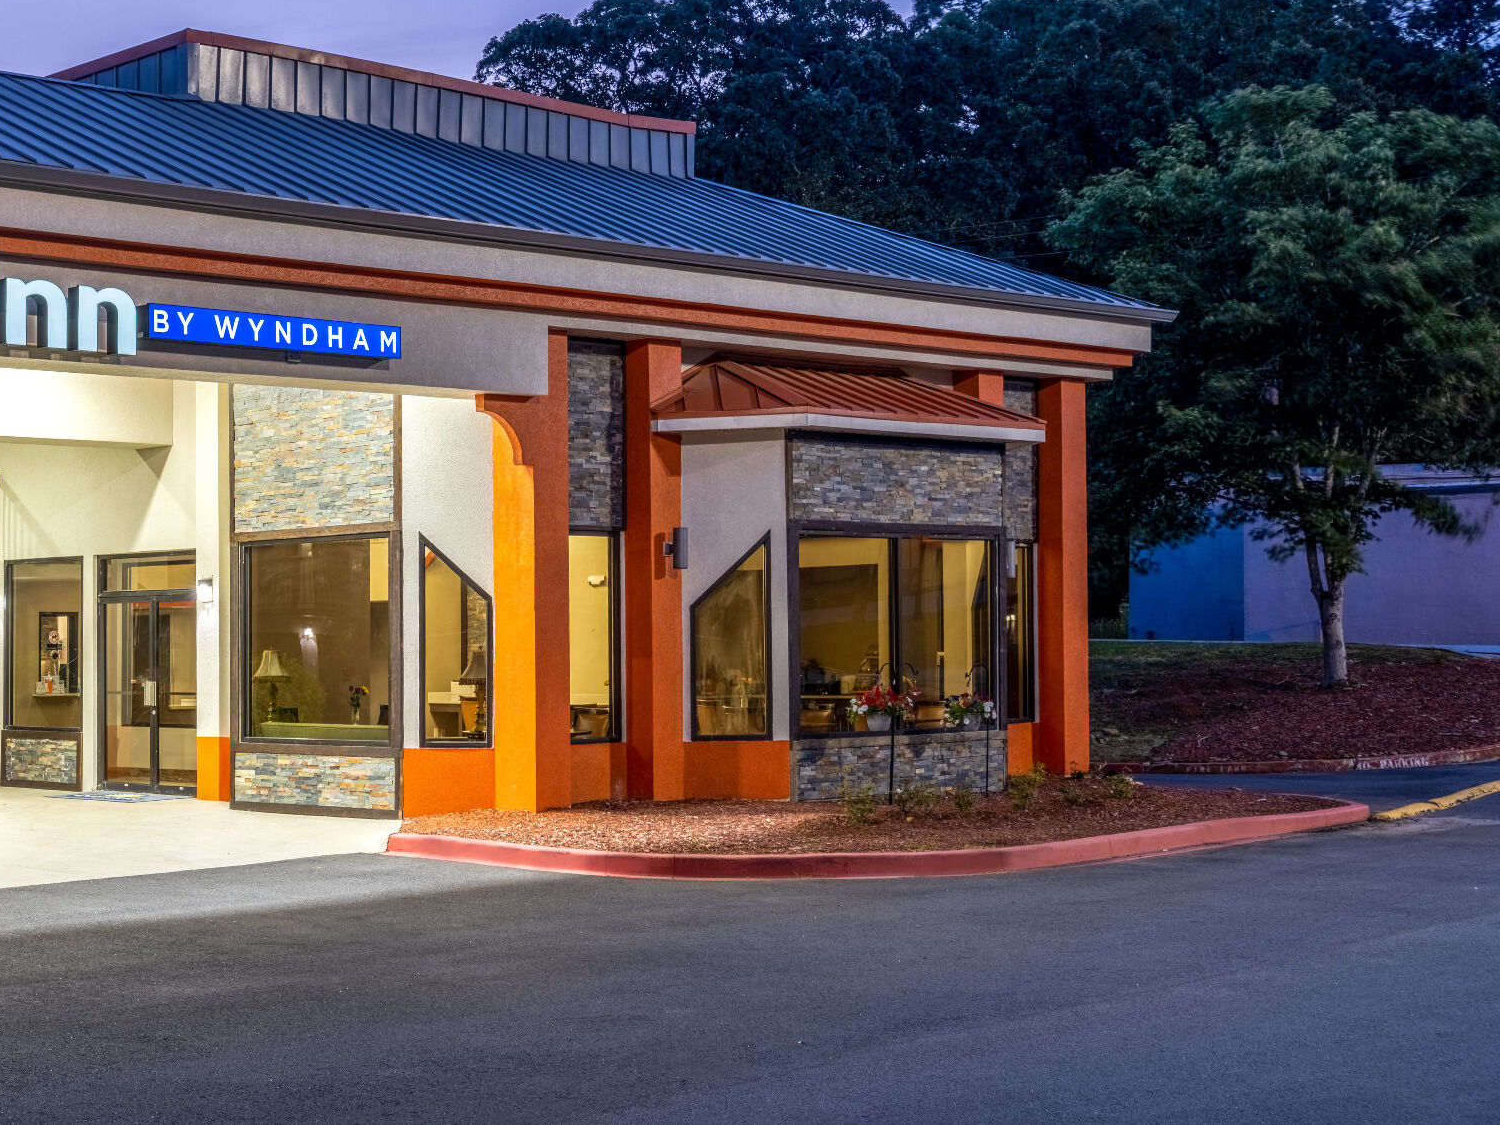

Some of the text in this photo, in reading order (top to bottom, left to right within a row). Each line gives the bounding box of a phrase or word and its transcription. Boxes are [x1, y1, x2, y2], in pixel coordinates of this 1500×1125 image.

[153, 309, 397, 353] BY WYNDHAM
[1380, 757, 1429, 769] PARKING
